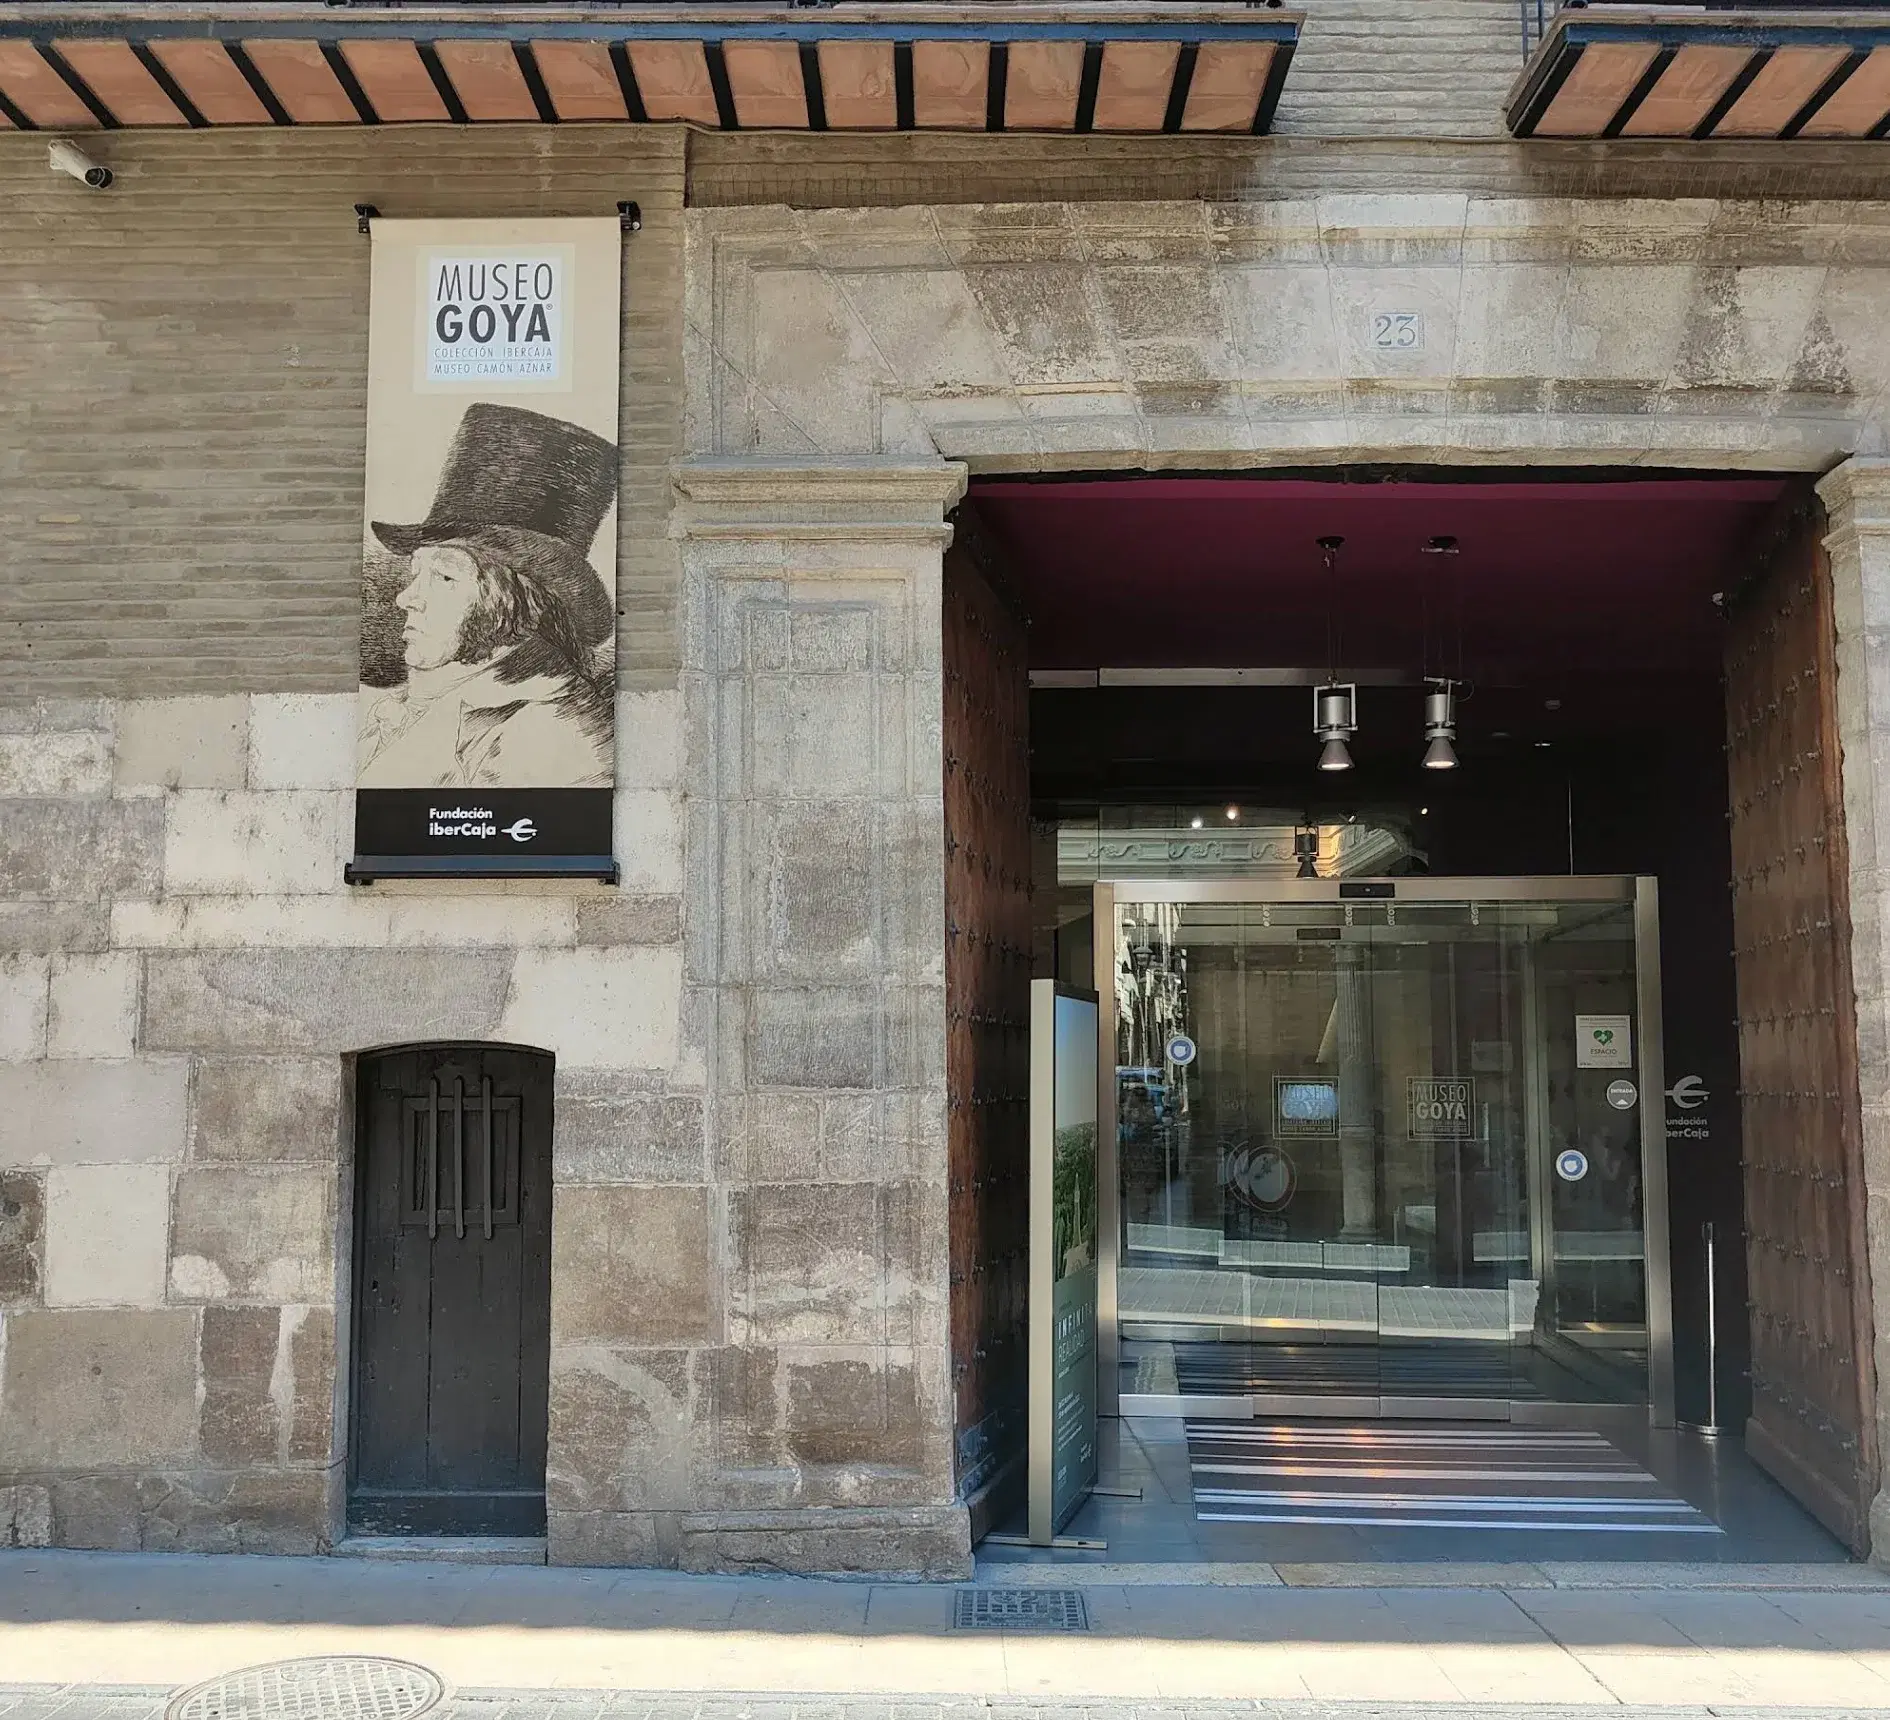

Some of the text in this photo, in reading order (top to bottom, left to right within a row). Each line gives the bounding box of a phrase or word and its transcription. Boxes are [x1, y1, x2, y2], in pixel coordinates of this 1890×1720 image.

[436, 263, 553, 302] MUSEO
[1374, 315, 1416, 346] 23
[434, 346, 552, 358] COLECCIÓN IBERCAJA
[434, 361, 552, 374] MUSEO CAMÓN AZNAR
[429, 806, 493, 819] Fundación
[1415, 1085, 1467, 1102] MUSEO
[1415, 1102, 1467, 1120] GOYA
[1666, 1116, 1708, 1126] undación
